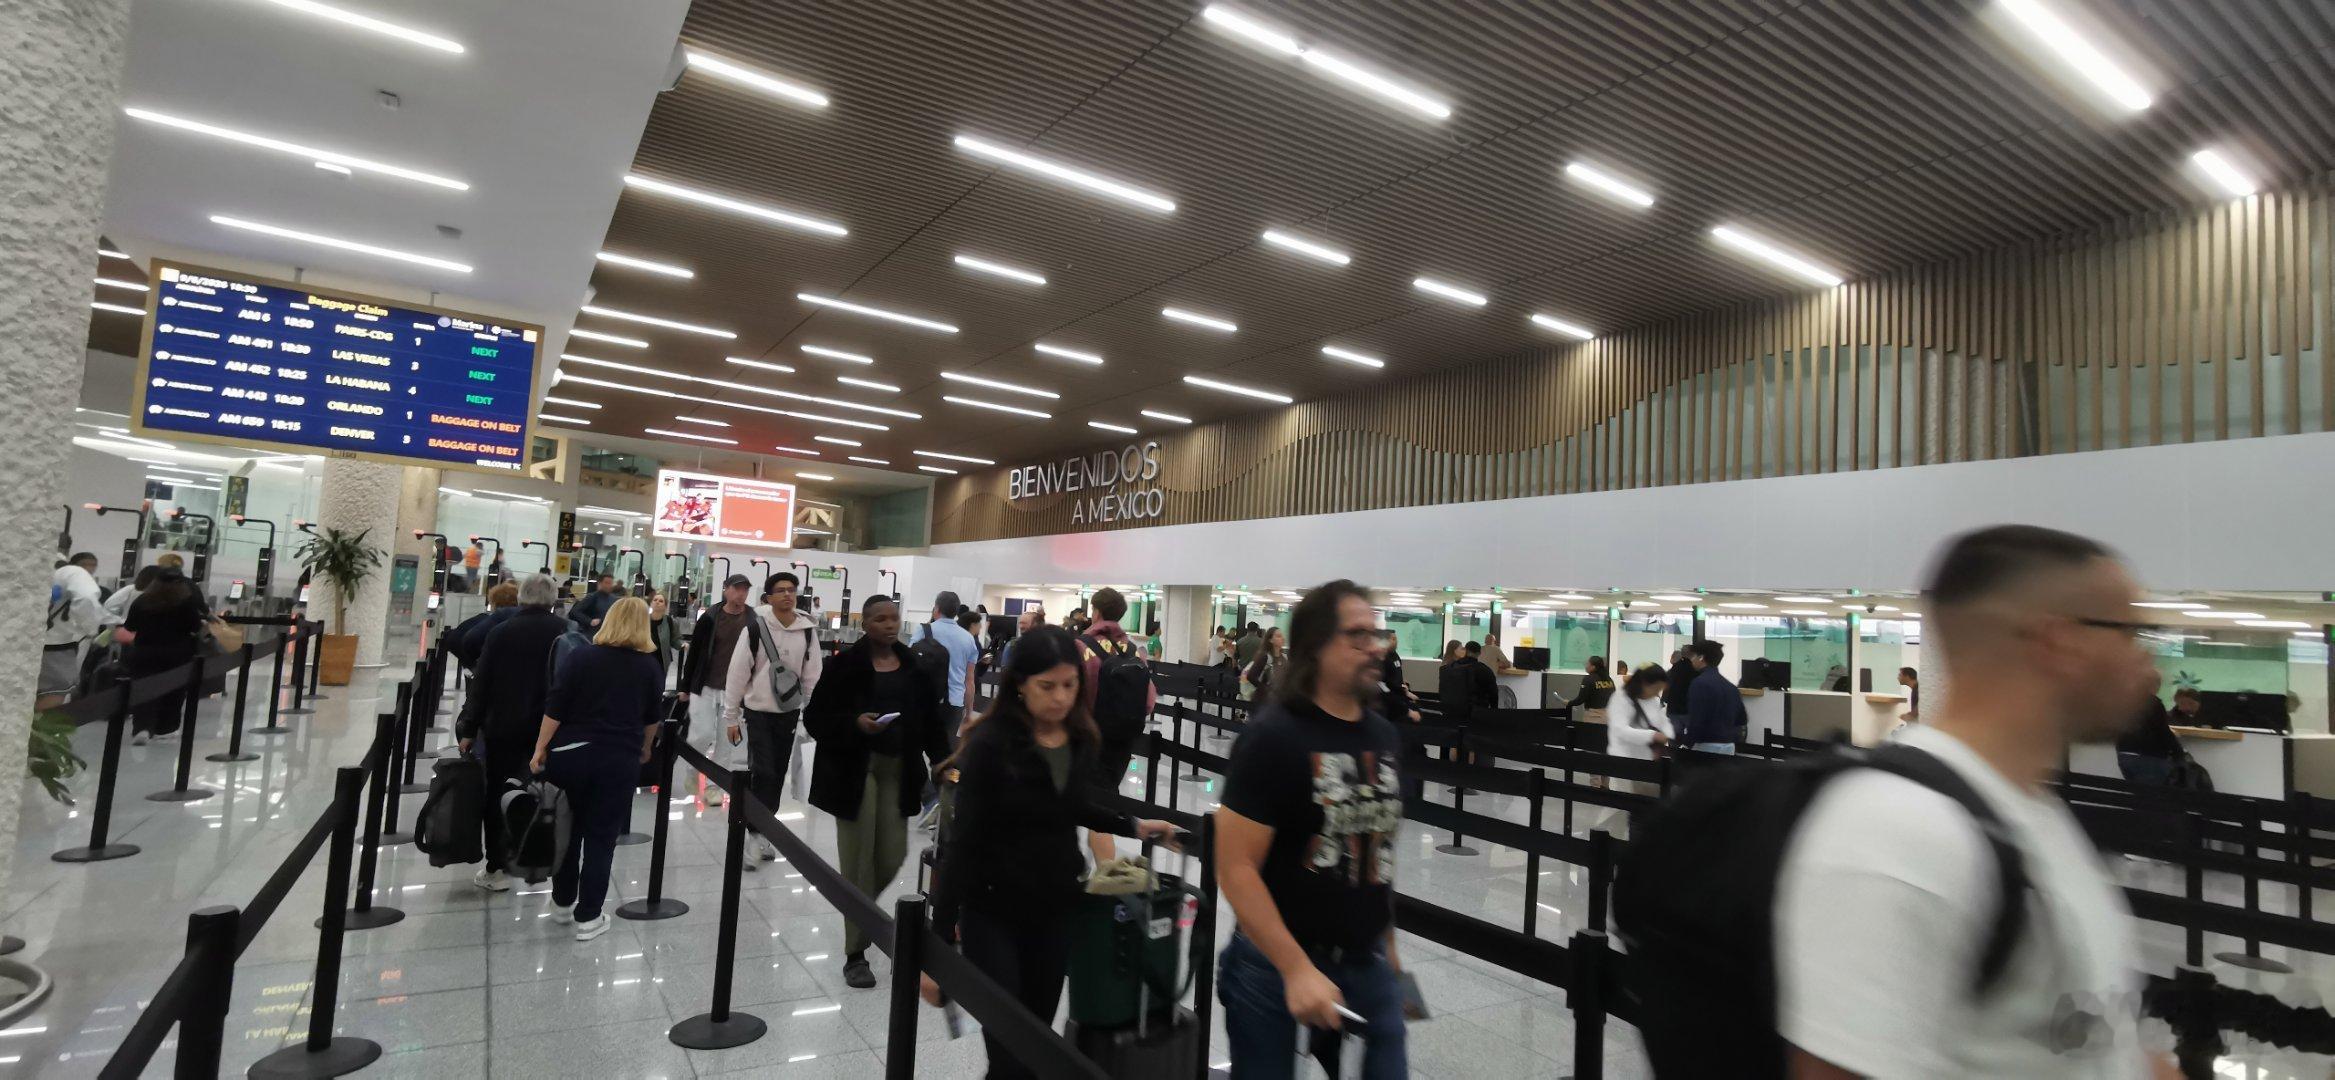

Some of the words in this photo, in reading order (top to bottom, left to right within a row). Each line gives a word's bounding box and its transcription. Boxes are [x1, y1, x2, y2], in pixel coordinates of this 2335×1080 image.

[308, 295, 356, 312] Baggage
[357, 304, 389, 317] Claim
[238, 309, 261, 321] AM
[335, 324, 394, 341] PARIS-CDG
[415, 337, 421, 346] 1
[471, 346, 499, 358] NEXT
[228, 334, 251, 346] AM
[332, 350, 354, 360] LAS
[355, 353, 391, 366] VEGAS
[469, 370, 496, 381] NEXT
[225, 360, 248, 372] AM
[325, 374, 341, 385] LA
[342, 377, 391, 392] HABANA
[408, 386, 417, 395] 4
[466, 394, 494, 405] NEXT
[221, 387, 245, 399] AM
[327, 400, 384, 416] ORLANDO
[406, 411, 413, 420] 1
[430, 413, 480, 428] BAGGAGE
[481, 420, 497, 430] ON
[498, 422, 522, 433] BELT
[218, 413, 241, 425] AM
[330, 426, 375, 440] DENVER
[428, 438, 477, 452] BAGGAGE
[478, 444, 495, 454] ON
[496, 446, 519, 457] BELT
[476, 459, 512, 469] WELCOME
[1009, 442, 1161, 500] BIENVENIDOS
[1071, 499, 1084, 525] A
[1088, 485, 1163, 524] MÉXICO
